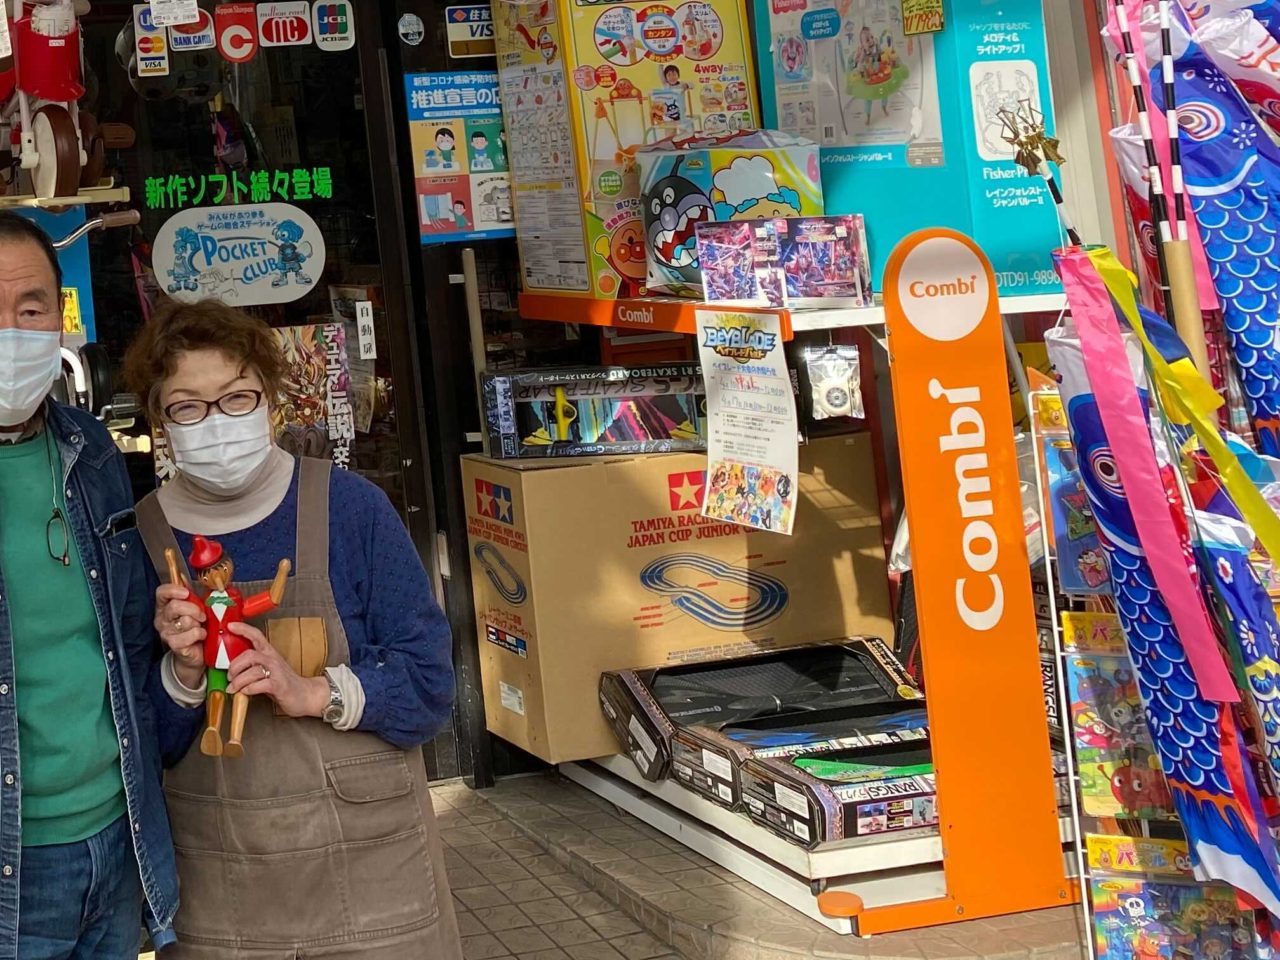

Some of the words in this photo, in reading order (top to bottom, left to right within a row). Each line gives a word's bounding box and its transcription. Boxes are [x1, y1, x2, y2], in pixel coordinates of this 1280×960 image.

[320, 16, 347, 24] JCB
[469, 24, 494, 38] VIS
[647, 29, 673, 38] カンタン
[173, 35, 193, 46] BANK
[193, 34, 211, 45] CARD
[145, 61, 162, 69] VISA
[983, 166, 1029, 180] Fisher-Pr
[145, 167, 333, 210] 新作ソフト続々登場
[198, 232, 268, 266] POCKET
[242, 257, 279, 284] CLUB
[909, 275, 977, 299] Combi
[618, 306, 654, 324] Combi
[360, 306, 373, 355] 自動扉
[703, 326, 777, 351] BEYBLADE
[610, 368, 677, 381] SKATEBOARD
[928, 377, 1005, 632] Combi
[631, 516, 675, 533] TAMIYA
[627, 531, 665, 549] JAPAN
[670, 528, 693, 543] CUP
[696, 523, 741, 540] JUNIOR
[870, 781, 919, 798] RANGS
